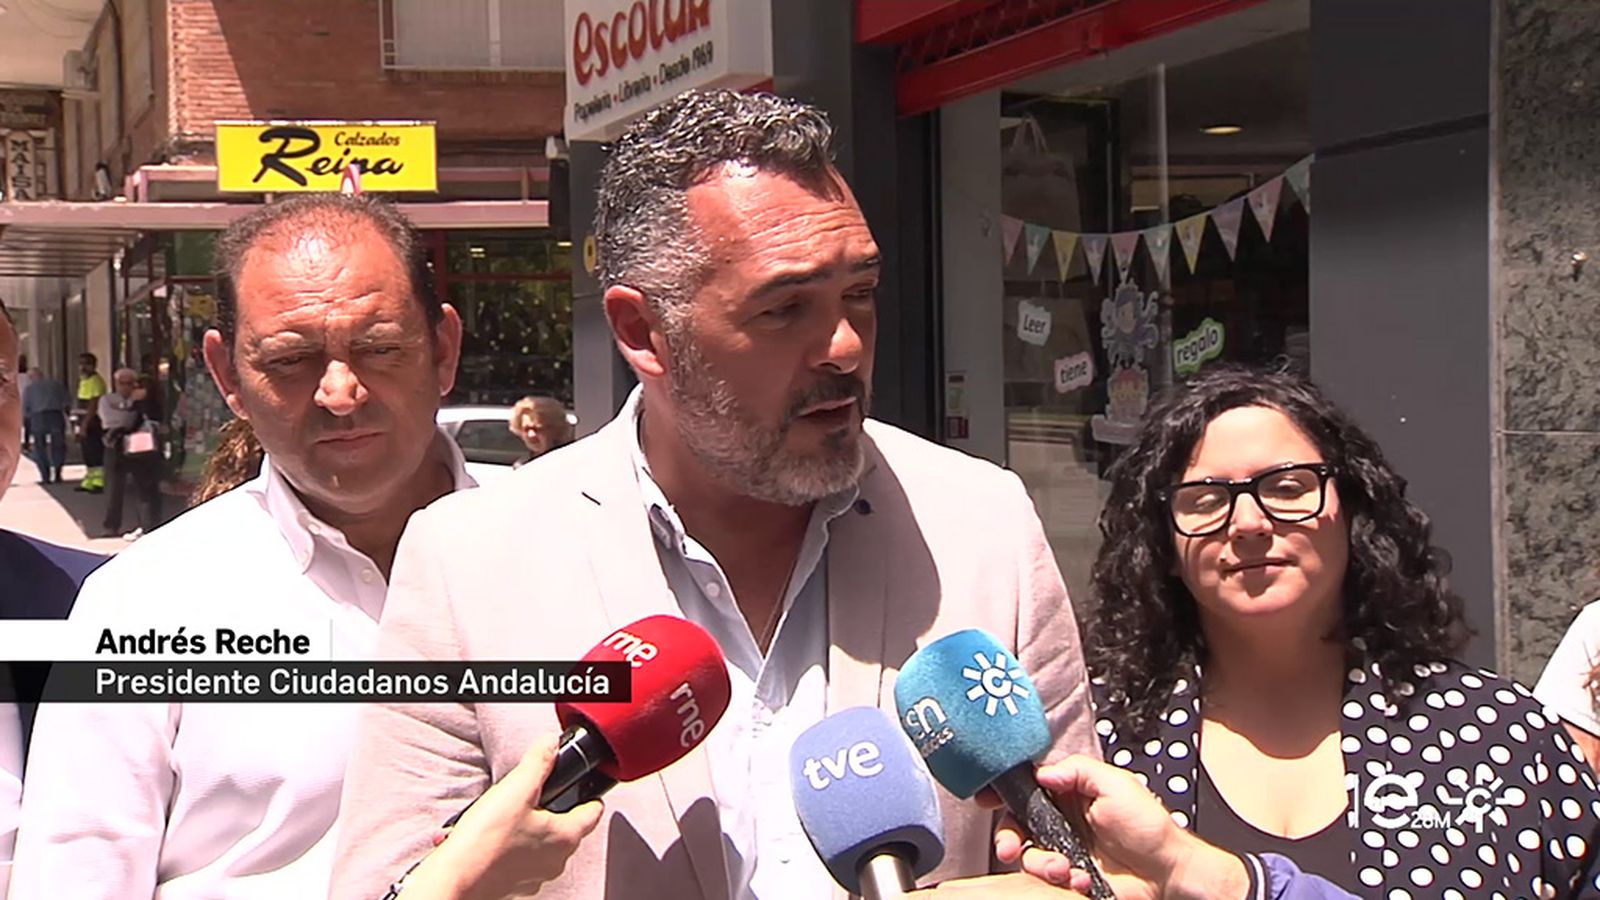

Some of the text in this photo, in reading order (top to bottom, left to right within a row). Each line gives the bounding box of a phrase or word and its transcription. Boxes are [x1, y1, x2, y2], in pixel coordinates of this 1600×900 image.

[252, 127, 404, 186] Reina
[334, 131, 400, 146] Calzados
[1023, 314, 1047, 334] Leer
[1177, 325, 1218, 365] regalo
[1061, 360, 1087, 384] tiene
[670, 682, 705, 747] rne
[803, 741, 884, 790] tve
